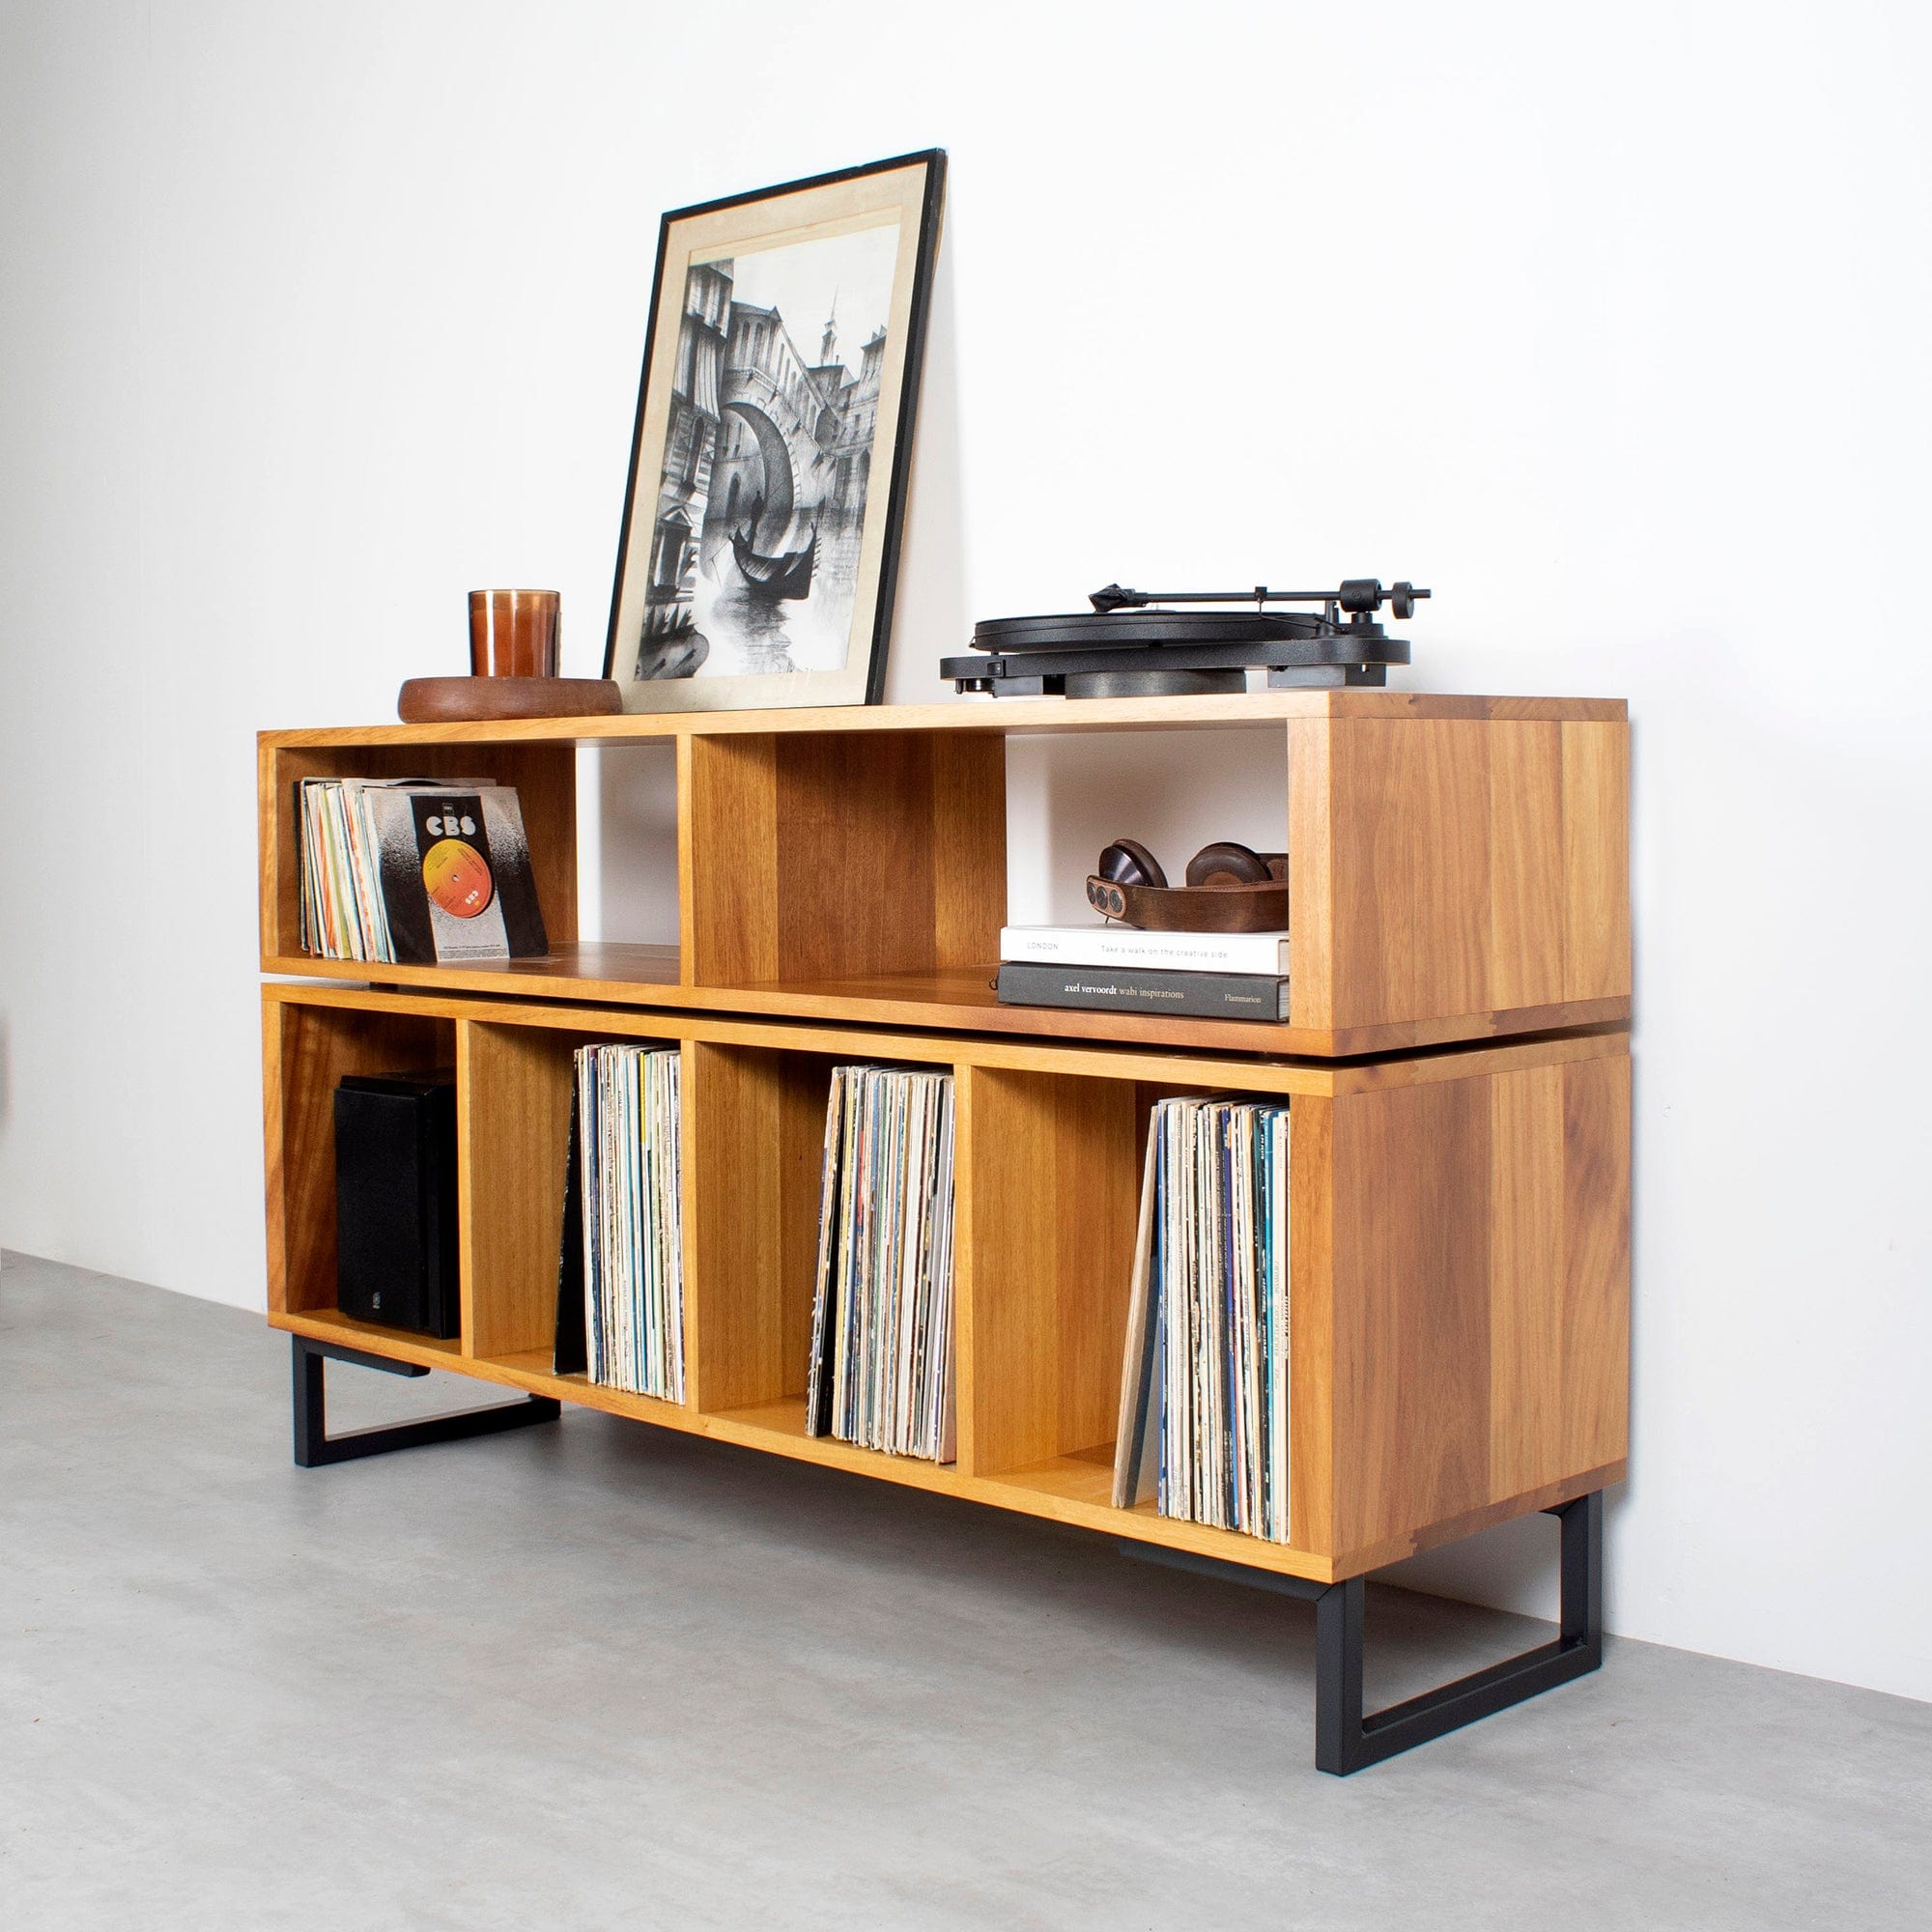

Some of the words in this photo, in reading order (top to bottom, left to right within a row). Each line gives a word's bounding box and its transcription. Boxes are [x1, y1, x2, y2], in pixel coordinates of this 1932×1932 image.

[426, 816, 476, 836] CBS
[1064, 982, 1080, 992] axel
[1081, 984, 1117, 995] vervoordt
[1119, 986, 1137, 996] wabi
[1139, 987, 1184, 999] inspirations
[1224, 994, 1262, 1003] Flammarion
